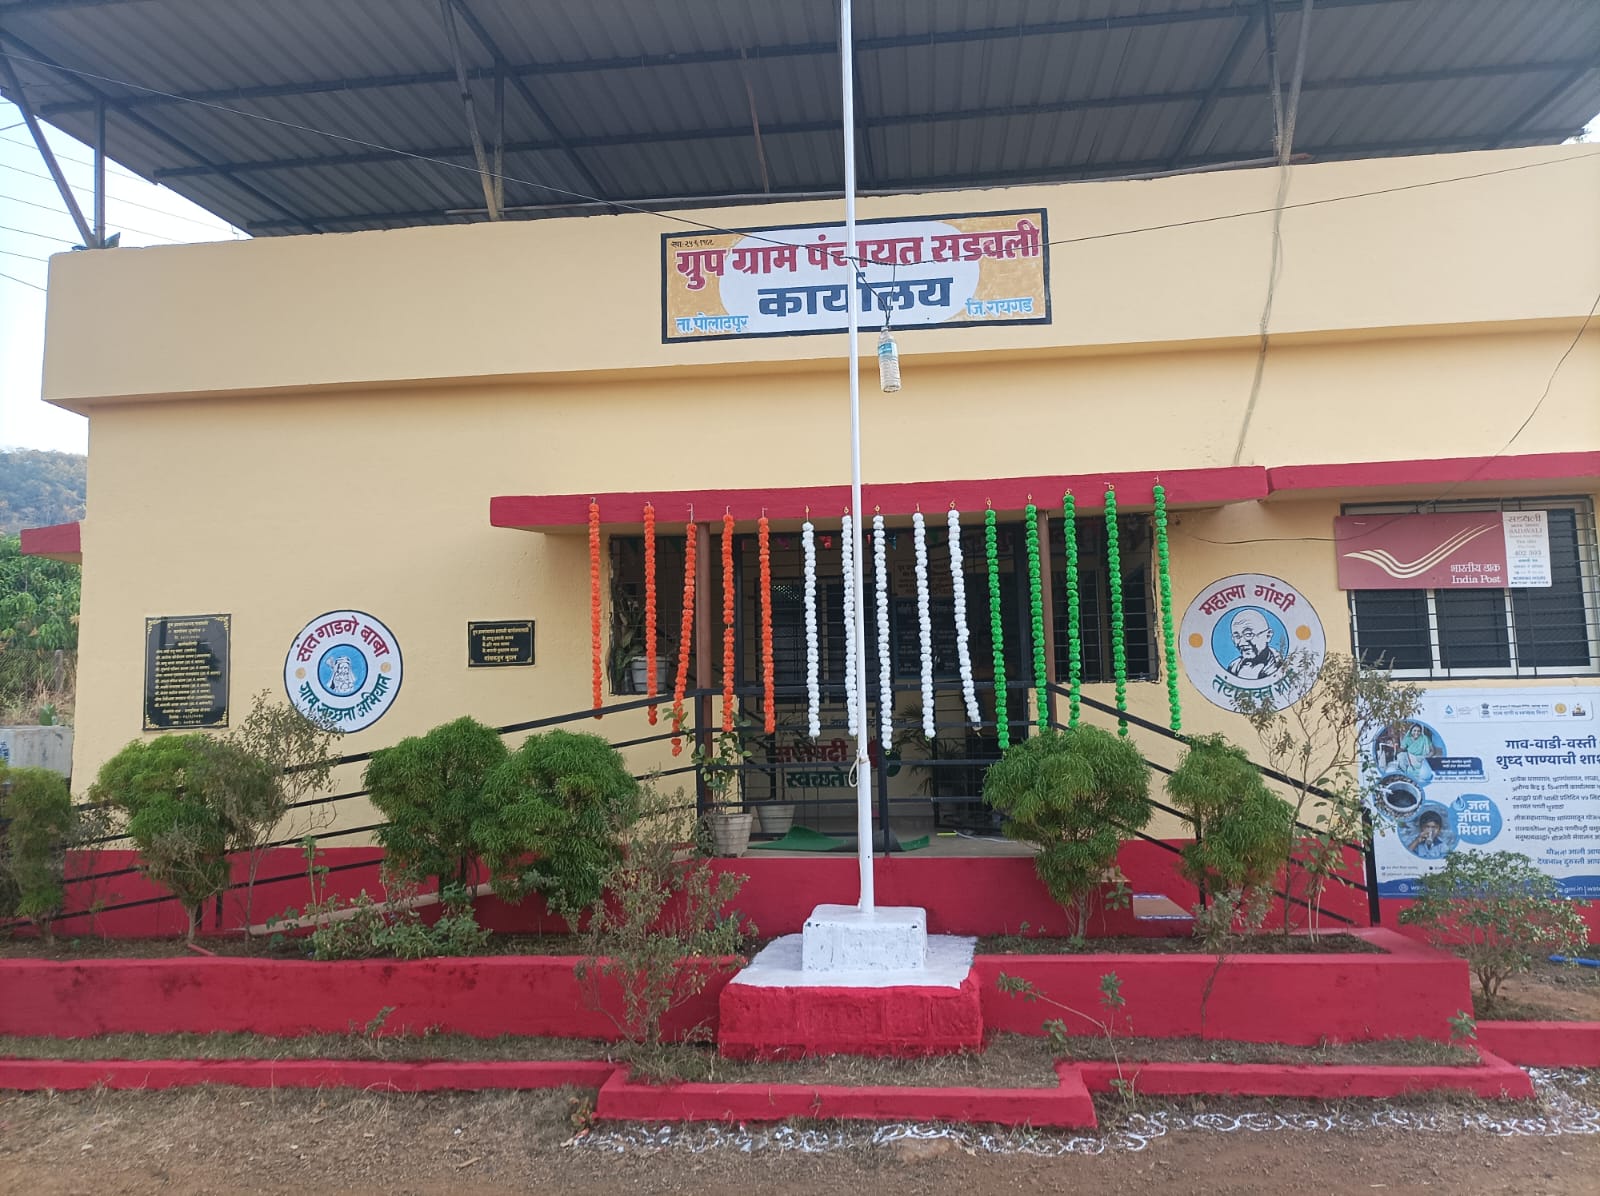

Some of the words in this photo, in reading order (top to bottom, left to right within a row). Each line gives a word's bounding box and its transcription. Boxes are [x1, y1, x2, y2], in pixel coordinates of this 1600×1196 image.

[676, 248, 727, 290] ग्रुप
[732, 244, 799, 275] ग्राम
[930, 219, 1040, 263] सडवली
[1452, 575, 1478, 584] India
[1480, 574, 1501, 584] Post
[1199, 584, 1246, 616] महात्मा
[1254, 583, 1296, 613] गांधी
[296, 633, 321, 663] संत
[315, 615, 360, 639] गाडगे
[361, 625, 390, 658] बाबा
[357, 673, 392, 718] अभियान
[1505, 735, 1597, 750] गाव-वाडी-वस्ती
[1524, 751, 1577, 765] पाण्याची
[786, 766, 857, 788] स्वच्छते
[1467, 800, 1490, 811] जल
[1456, 809, 1490, 823] जीवन
[1456, 823, 1491, 836] मिशन
